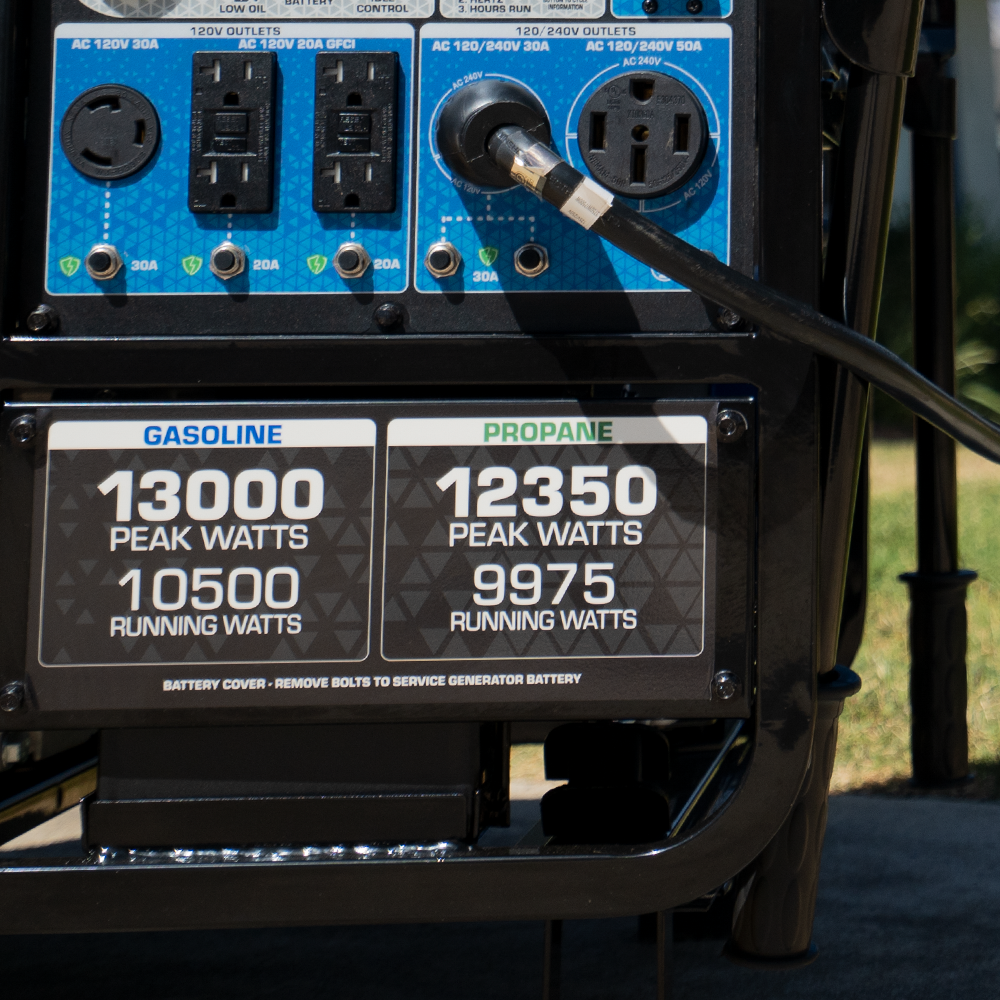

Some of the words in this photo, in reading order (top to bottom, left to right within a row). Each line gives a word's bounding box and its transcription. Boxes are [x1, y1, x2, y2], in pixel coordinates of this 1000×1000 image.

[219, 4, 246, 14] LOW
[248, 4, 266, 14] OIL
[356, 4, 409, 13] CONTROL
[458, 4, 467, 13] 3.
[469, 4, 506, 13] HOURS
[508, 5, 532, 13] RUN
[548, 3, 583, 11] INFORMATION
[190, 26, 223, 36] 120V
[226, 26, 281, 36] OUTLETS
[516, 26, 580, 36] 120/240V
[582, 26, 636, 36] OUTLETS
[72, 38, 91, 49] AC
[94, 38, 129, 49] 120V
[131, 38, 159, 49] 30A
[239, 38, 256, 49] AC
[260, 38, 294, 49] 120V
[297, 38, 324, 50] 20A
[326, 38, 355, 49] GFCI
[431, 40, 451, 52] AC
[453, 41, 521, 53] 120/240V
[523, 40, 550, 52] 30A
[585, 40, 605, 52] AC
[607, 41, 673, 53] 120/240V
[676, 40, 703, 52] 50A
[622, 57, 637, 66] AC
[638, 56, 661, 66] 240V
[452, 79, 464, 90] AC
[463, 71, 483, 84] 240V
[451, 178, 464, 188] AC
[463, 182, 482, 194] 120V
[683, 186, 698, 202] AC
[695, 171, 713, 192] 120V
[131, 260, 158, 271] 30A
[252, 259, 280, 271] 20A
[373, 258, 401, 270] 20A
[473, 271, 498, 282] 30A
[143, 424, 283, 446] GASOLINE
[483, 421, 613, 443] PROPANE
[97, 469, 324, 521] 13000
[436, 465, 657, 517] 12350
[111, 526, 191, 551] PEAK
[201, 525, 308, 550] WATTS
[449, 522, 528, 546] PEAK
[537, 521, 642, 546] WATTS
[119, 567, 299, 610] 10500
[473, 563, 614, 606] 9975
[111, 615, 217, 636] RUNNING
[223, 614, 301, 635] WATTS
[451, 610, 554, 631] RUNNING
[560, 609, 636, 630] WATTS
[163, 679, 220, 691] BATTERY
[222, 678, 266, 690] COVER
[274, 677, 329, 689] REMOVE
[331, 676, 371, 688] BOLTS
[373, 676, 391, 688] TO
[392, 675, 446, 687] SERVICE
[447, 674, 524, 686] GENERATOR
[526, 673, 582, 685] BATTERY
